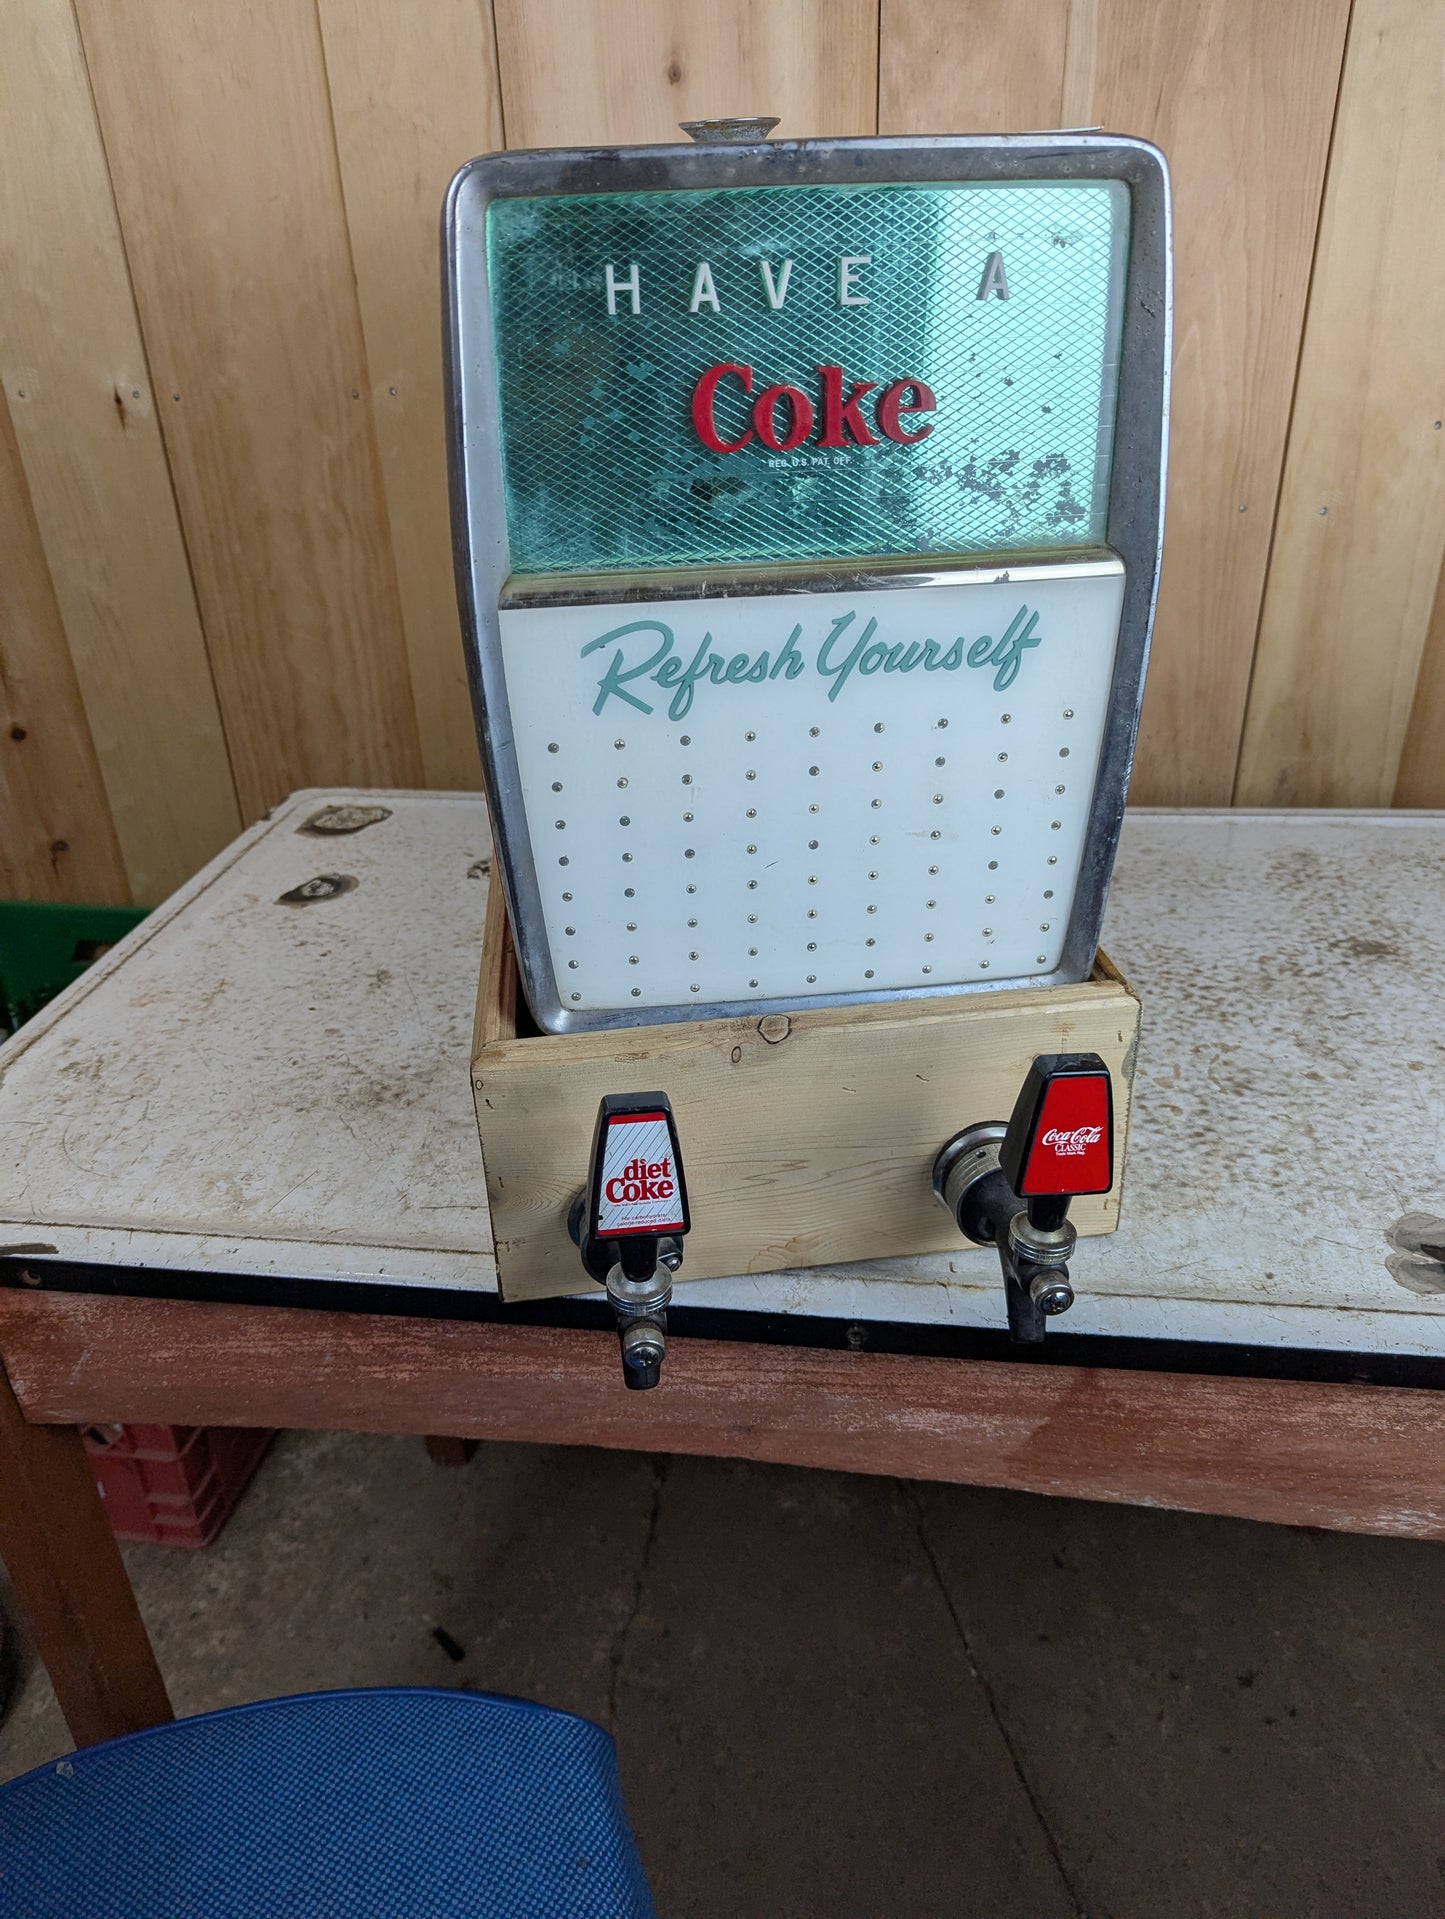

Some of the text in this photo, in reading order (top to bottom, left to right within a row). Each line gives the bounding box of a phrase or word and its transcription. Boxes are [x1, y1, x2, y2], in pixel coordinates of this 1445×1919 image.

[604, 251, 1010, 315] HAVE A
[692, 362, 938, 454] Coke
[580, 603, 1042, 722] Refresh Yourself
[1041, 1126, 1104, 1146] Coca-Cola
[1054, 1143, 1087, 1152] CLASSIC
[623, 1157, 671, 1182] diet
[605, 1177, 674, 1204] Coke
